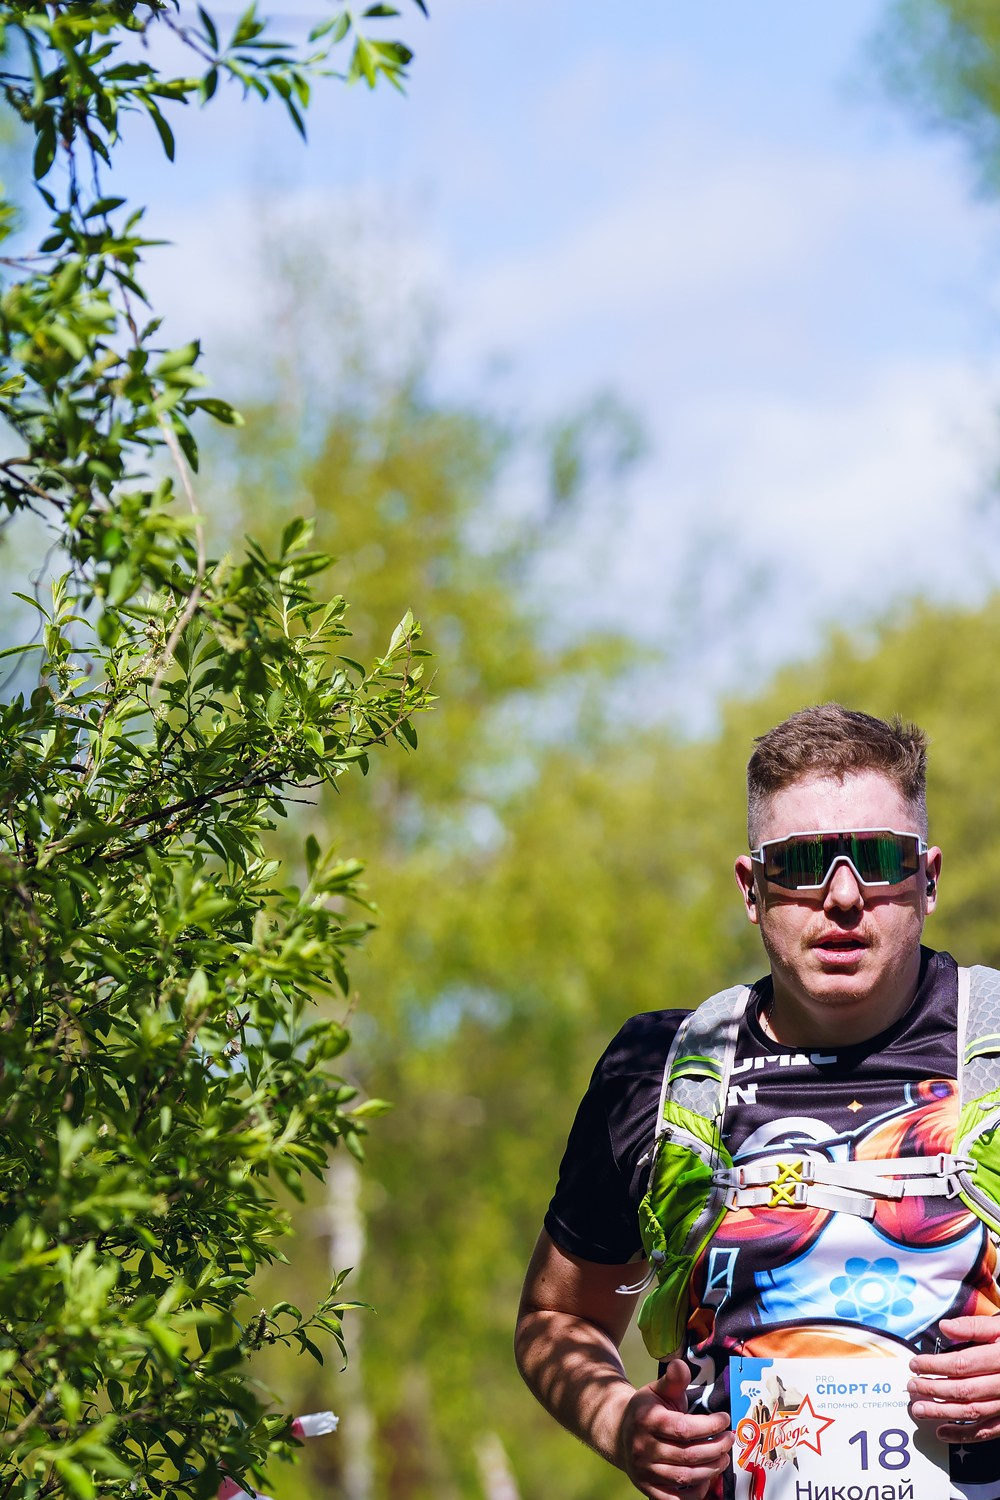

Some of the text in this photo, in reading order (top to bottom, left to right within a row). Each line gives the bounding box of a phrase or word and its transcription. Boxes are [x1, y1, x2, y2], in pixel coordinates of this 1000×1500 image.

[815, 1375, 835, 1383] PRO
[816, 1383, 891, 1395] СПОРТ 40
[862, 1400, 912, 1409] СТРЕЛКОВК
[736, 1418, 761, 1469] 9
[848, 1428, 911, 1471] 18
[795, 1478, 914, 1500] Николай
